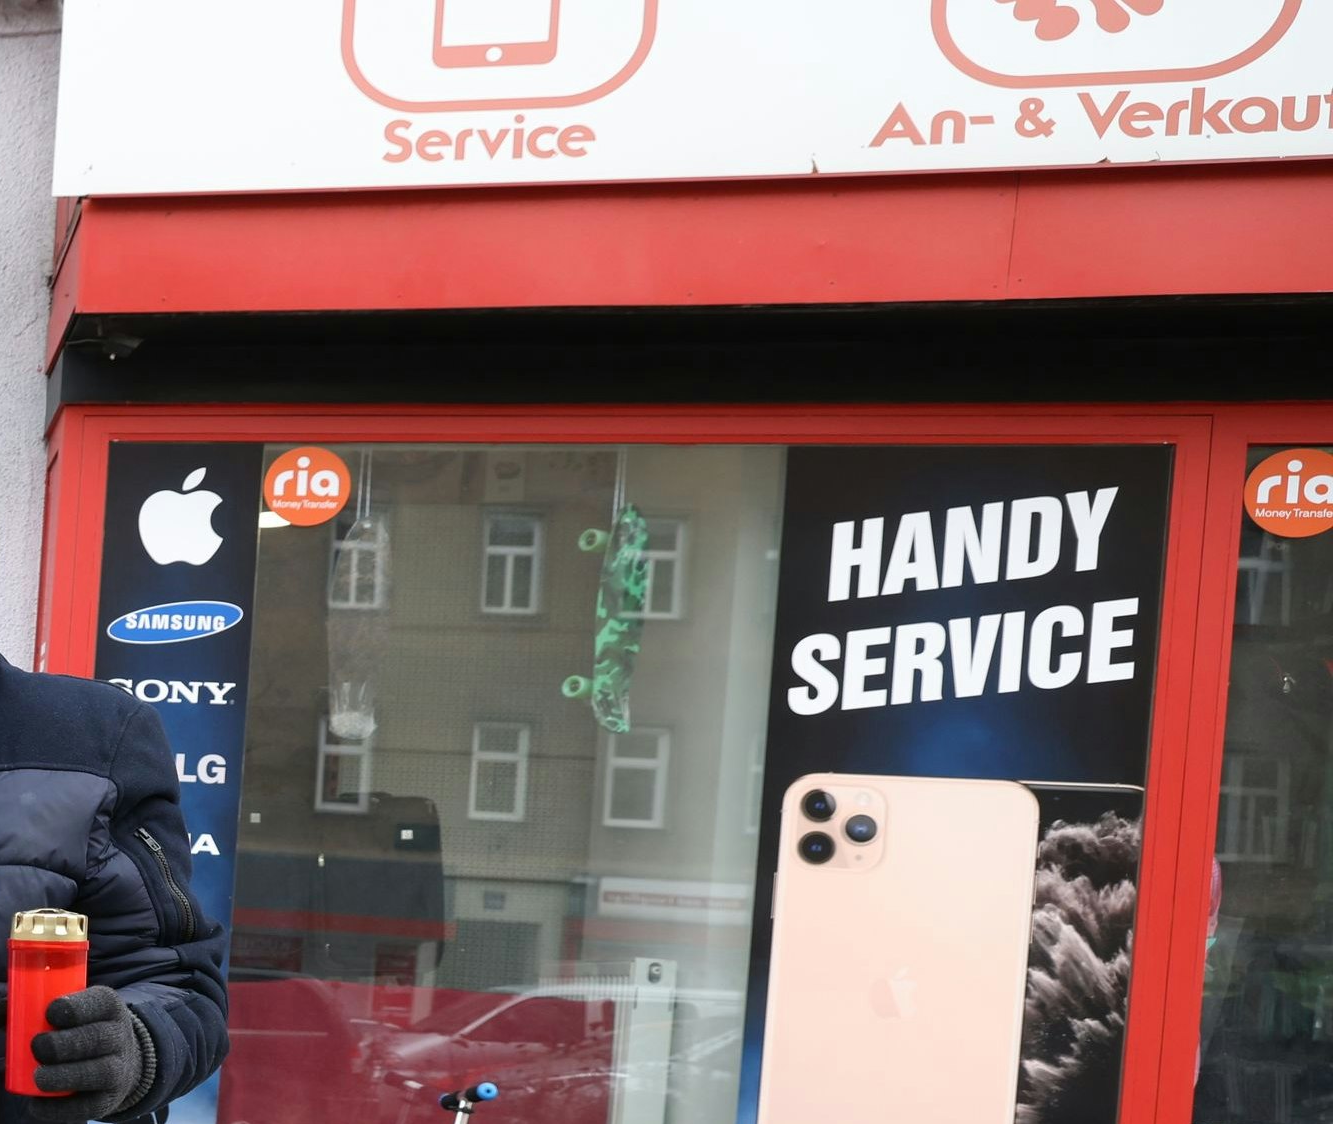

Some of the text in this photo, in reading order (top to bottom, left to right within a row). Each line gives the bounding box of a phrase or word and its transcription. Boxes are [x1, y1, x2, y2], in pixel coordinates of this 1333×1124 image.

[382, 114, 596, 163] Service
[868, 101, 995, 147] An-
[1014, 97, 1057, 138] &
[274, 456, 339, 497] ria
[1256, 459, 1333, 503] ria
[271, 499, 338, 511] Money Transfer
[1255, 508, 1333, 519] Money Transfe
[827, 486, 1119, 602] HANDY
[124, 613, 226, 631] SAMSUNG
[787, 597, 1139, 715] SERVICE
[108, 678, 236, 704] SONY
[174, 753, 226, 784] LG
